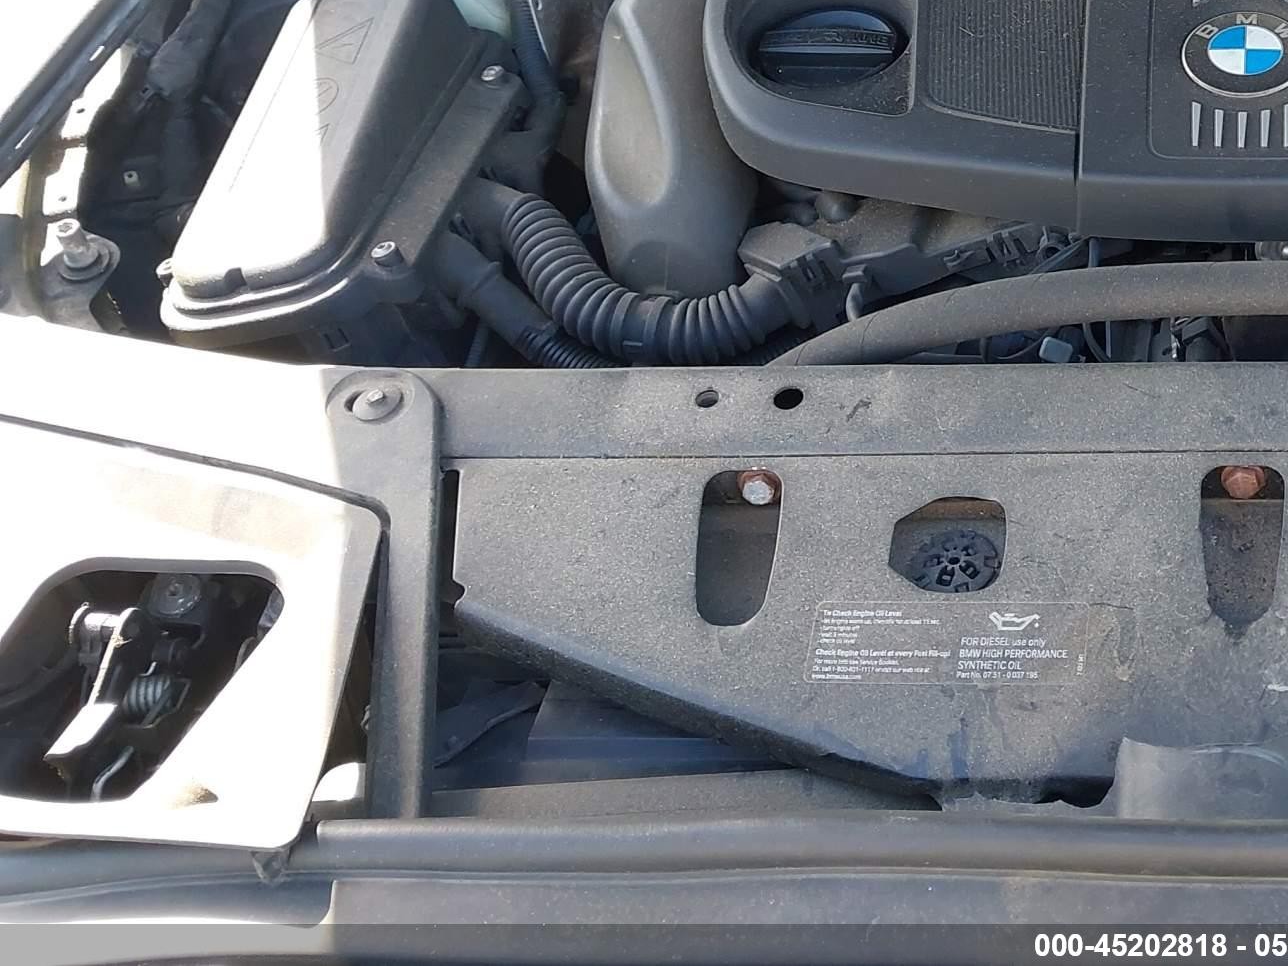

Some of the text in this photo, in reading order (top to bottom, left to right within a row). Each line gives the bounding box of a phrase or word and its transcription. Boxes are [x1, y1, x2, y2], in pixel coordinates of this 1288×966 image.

[852, 610, 874, 618] Engine
[961, 636, 1046, 648] FOR DIESEL use only
[815, 648, 836, 656] Check
[837, 648, 859, 658] Engine
[869, 649, 887, 657] Level
[895, 650, 914, 658] every
[959, 649, 1069, 659] BMW HIGH PERFORMANCE
[958, 660, 1022, 670] SYNTHETIC OIL
[956, 671, 969, 679] Part
[970, 671, 981, 679] No.
